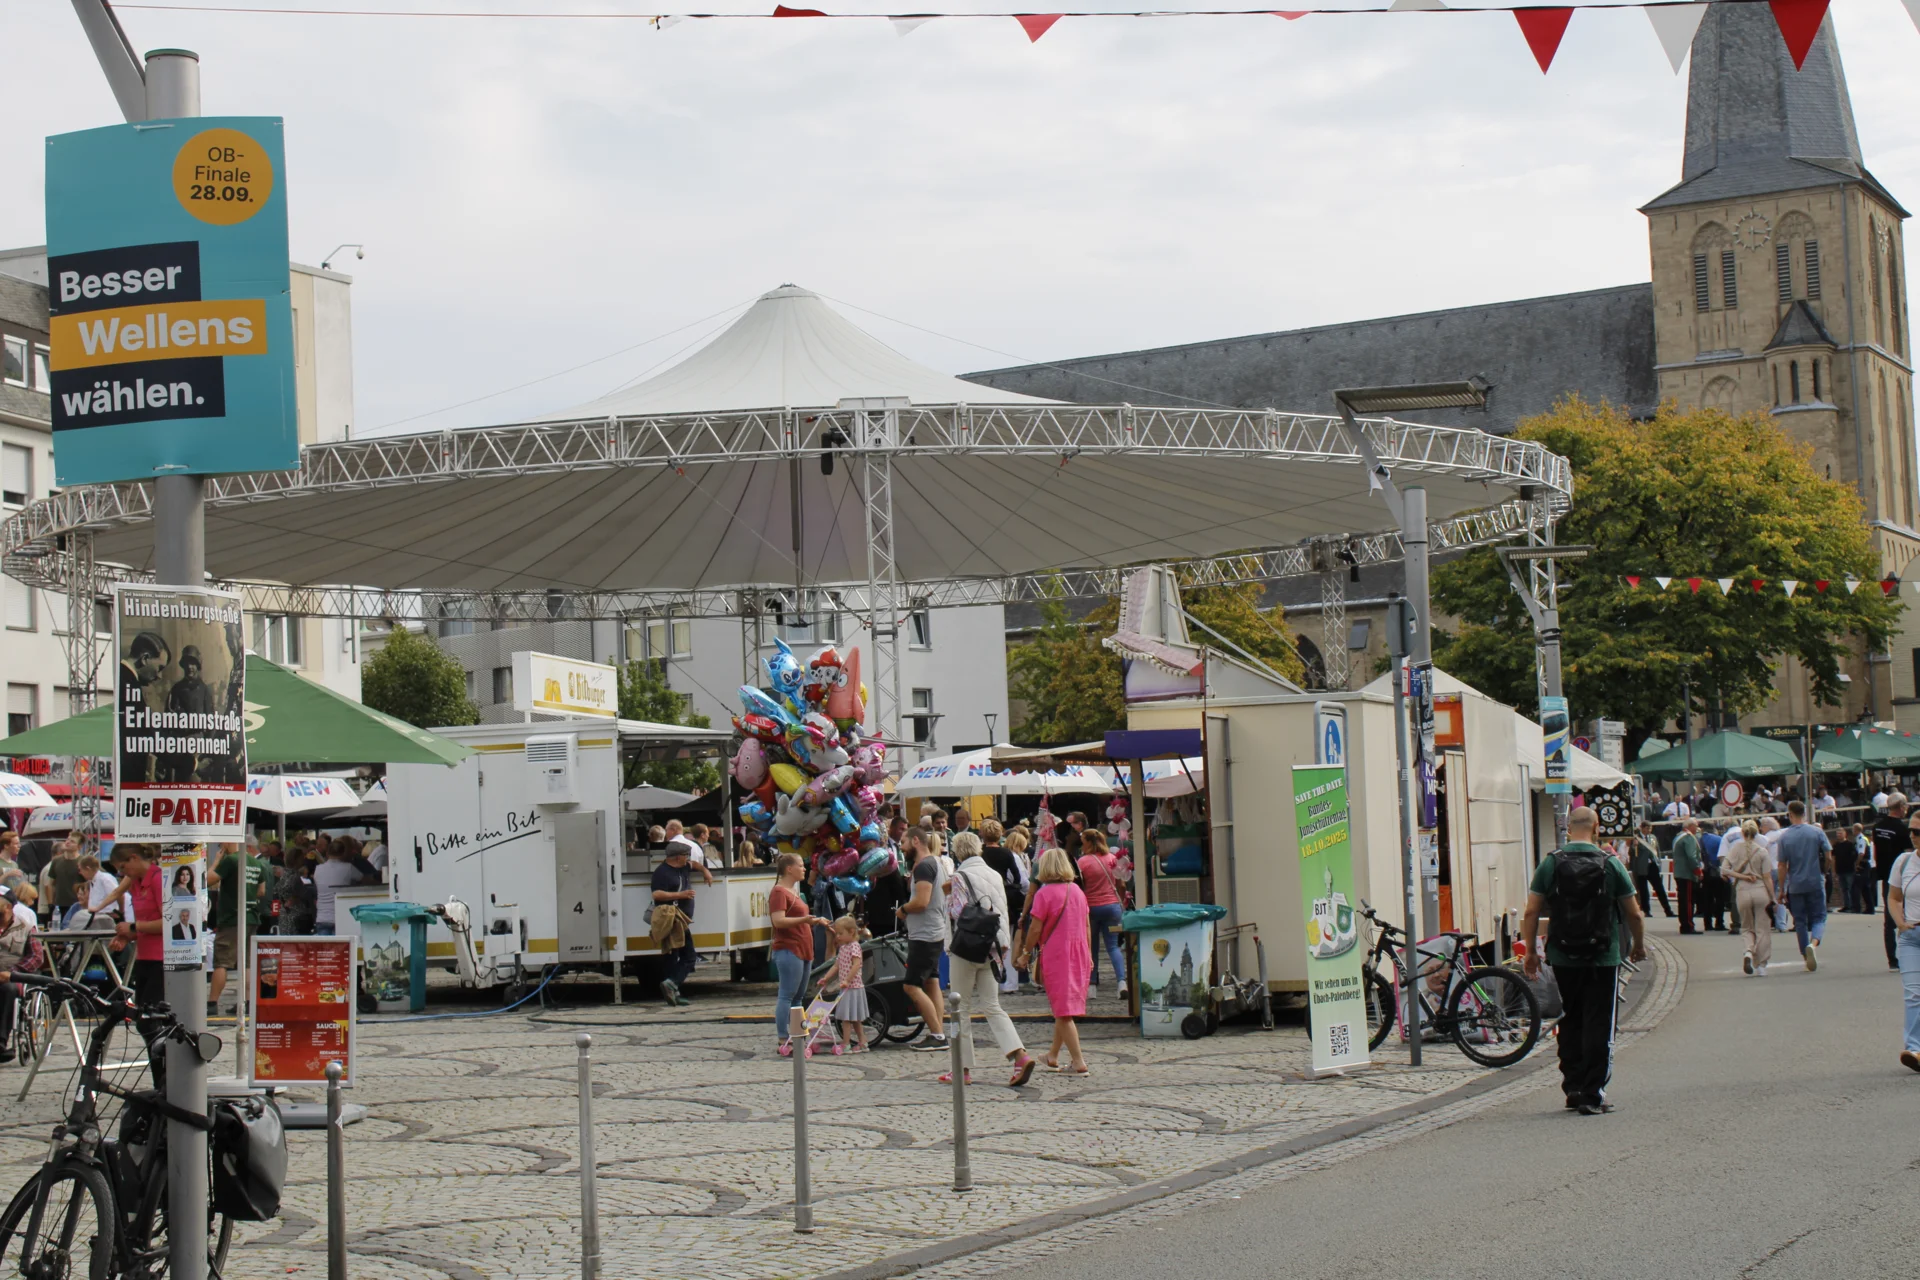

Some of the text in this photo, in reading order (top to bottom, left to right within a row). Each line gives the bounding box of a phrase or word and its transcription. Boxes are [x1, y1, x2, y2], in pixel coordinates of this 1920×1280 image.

[208, 147, 244, 163] OB-
[194, 166, 251, 183] Finale
[190, 185, 254, 202] 28.09.
[59, 265, 182, 302] Besser
[78, 313, 254, 356] Wellens
[61, 379, 205, 417] wählen.
[124, 598, 240, 624] Hindenburgstraße
[125, 683, 141, 702] in
[125, 706, 241, 732] Erlemannstraße
[1773, 727, 1799, 735] Bolten
[125, 731, 231, 755] umbenennen!
[912, 764, 953, 780] NEW
[286, 780, 331, 798] NEW
[1295, 777, 1344, 805] SAVE THE DATE
[125, 797, 242, 826] Die PARTEI
[1307, 800, 1332, 817] Bundes-
[427, 810, 542, 856] Bitte ein Bit
[1301, 829, 1348, 858] 18.10.2025
[573, 901, 584, 914] 4
[1314, 902, 1327, 916] BJT
[257, 947, 281, 955] BURGER
[1314, 976, 1359, 990] Wir sehen uns in
[256, 1022, 284, 1030] BEILAGEN
[316, 1022, 341, 1030] SAUCEN
